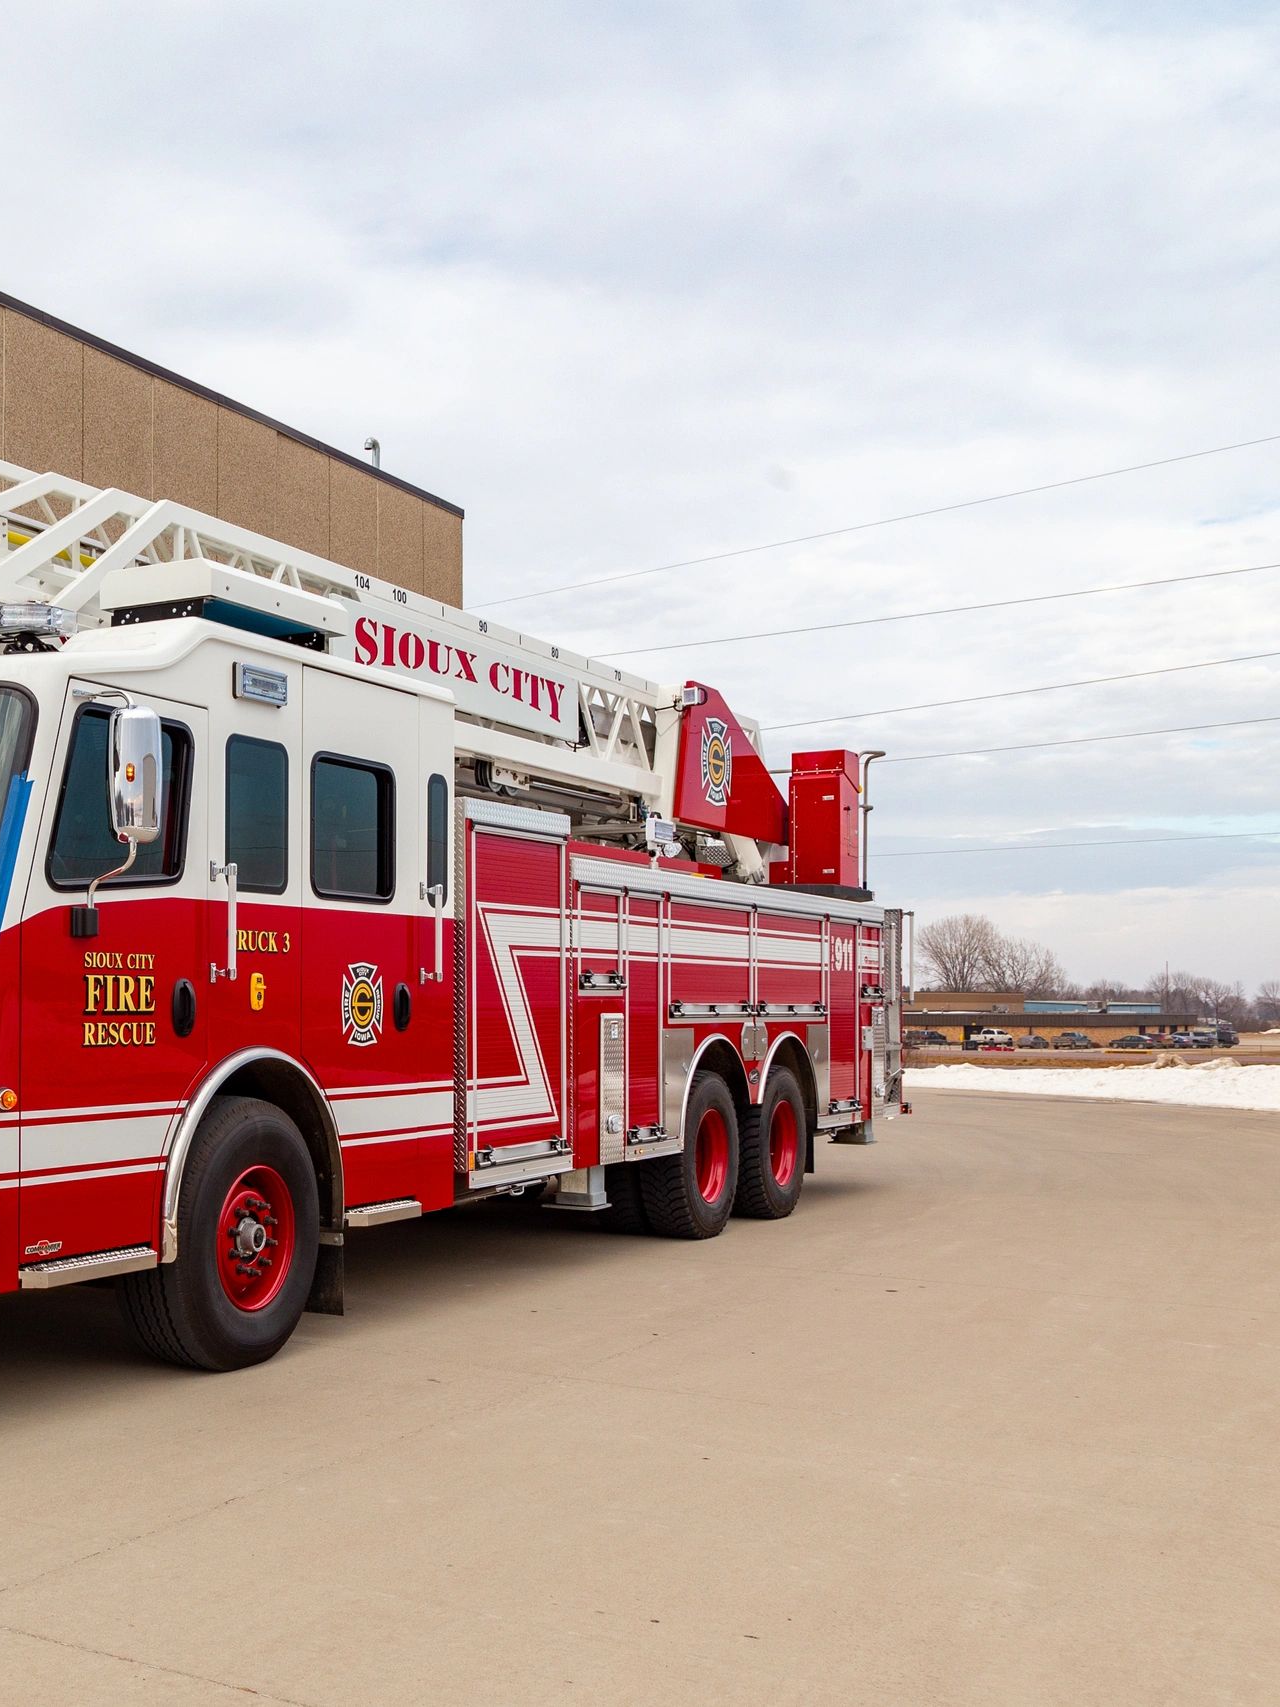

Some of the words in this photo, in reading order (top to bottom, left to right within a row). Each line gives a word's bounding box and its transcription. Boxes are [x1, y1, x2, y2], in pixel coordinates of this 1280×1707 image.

[354, 574, 370, 591] 104
[392, 588, 407, 604] 100
[478, 620, 488, 633] 90
[551, 647, 559, 659] 80
[354, 616, 478, 683] SIOUX
[489, 662, 565, 723] CITY
[614, 669, 622, 681] 70
[236, 929, 278, 952] RUCK
[282, 932, 290, 953] 3
[84, 952, 123, 969] SIOUX
[127, 953, 155, 970] CITY
[835, 936, 853, 971] 911
[84, 974, 156, 1014] FIRE
[83, 1022, 156, 1046] RESCUE
